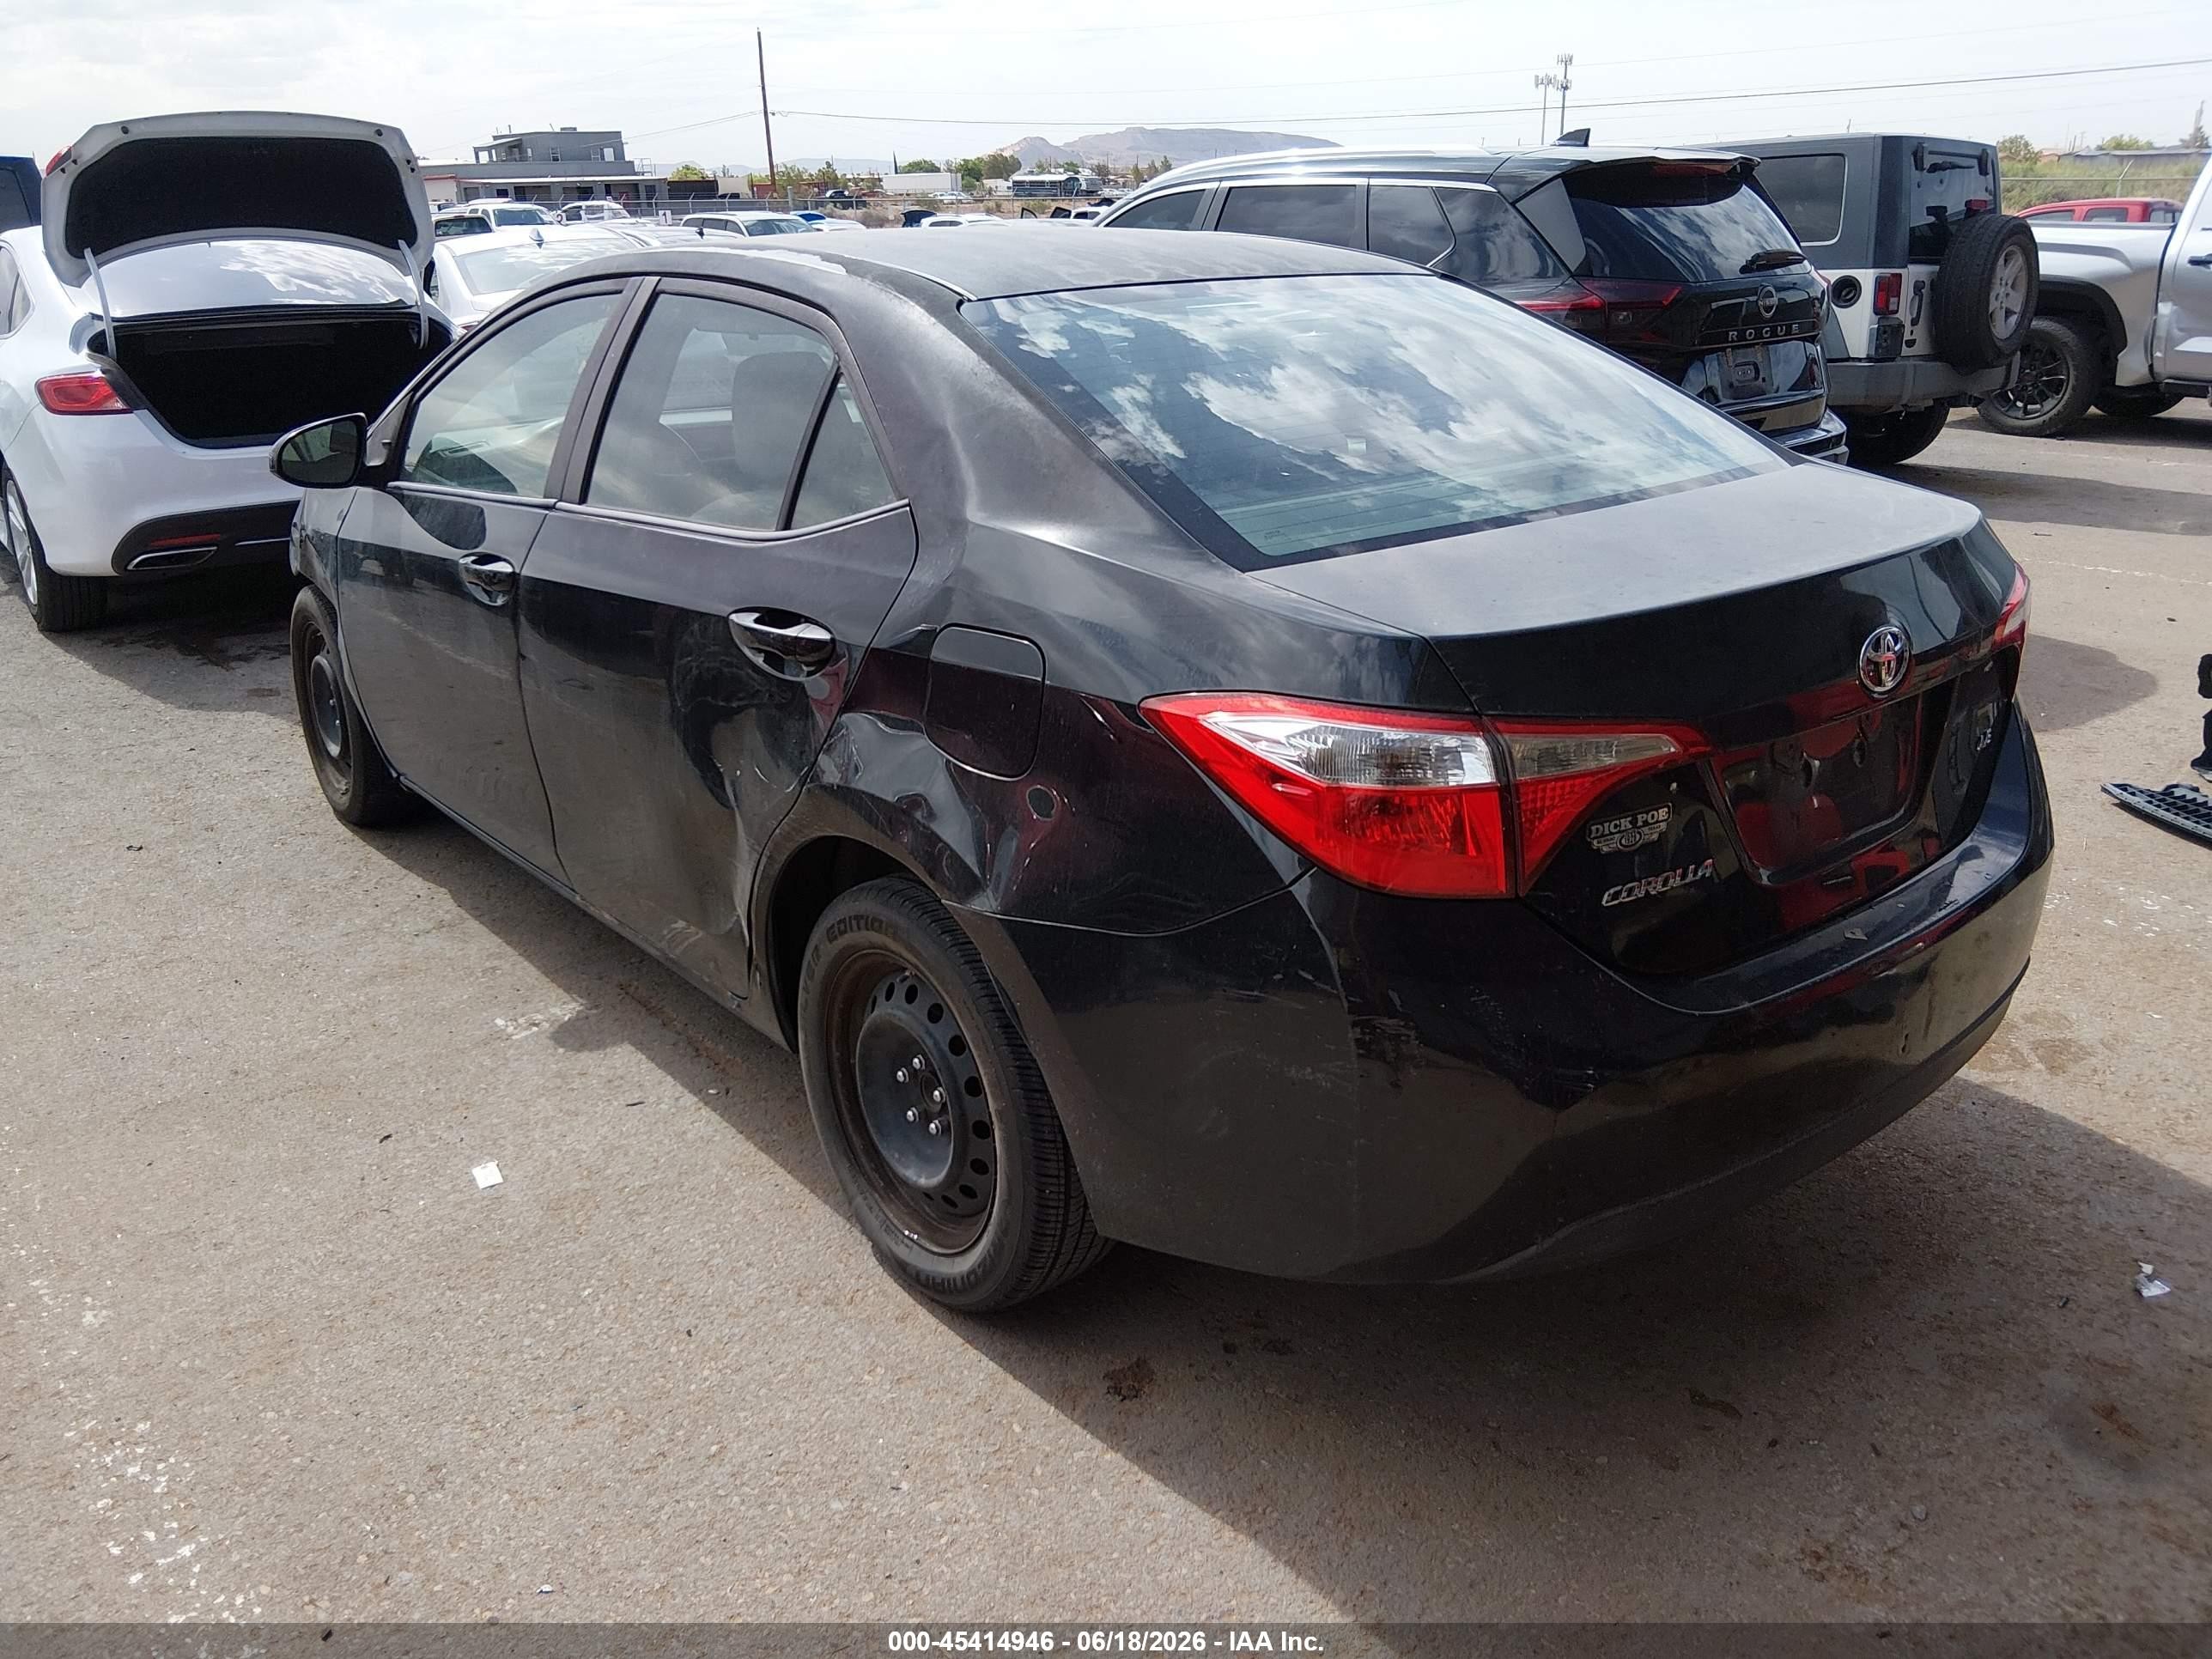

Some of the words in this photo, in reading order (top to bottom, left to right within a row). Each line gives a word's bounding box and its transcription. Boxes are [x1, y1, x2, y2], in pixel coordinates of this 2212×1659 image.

[662, 211, 668, 224] 1
[1728, 324, 1801, 342] ROGUE
[1590, 817, 1632, 838] DICK
[1637, 807, 1668, 826] POE
[1601, 859, 1715, 907] COROLLA
